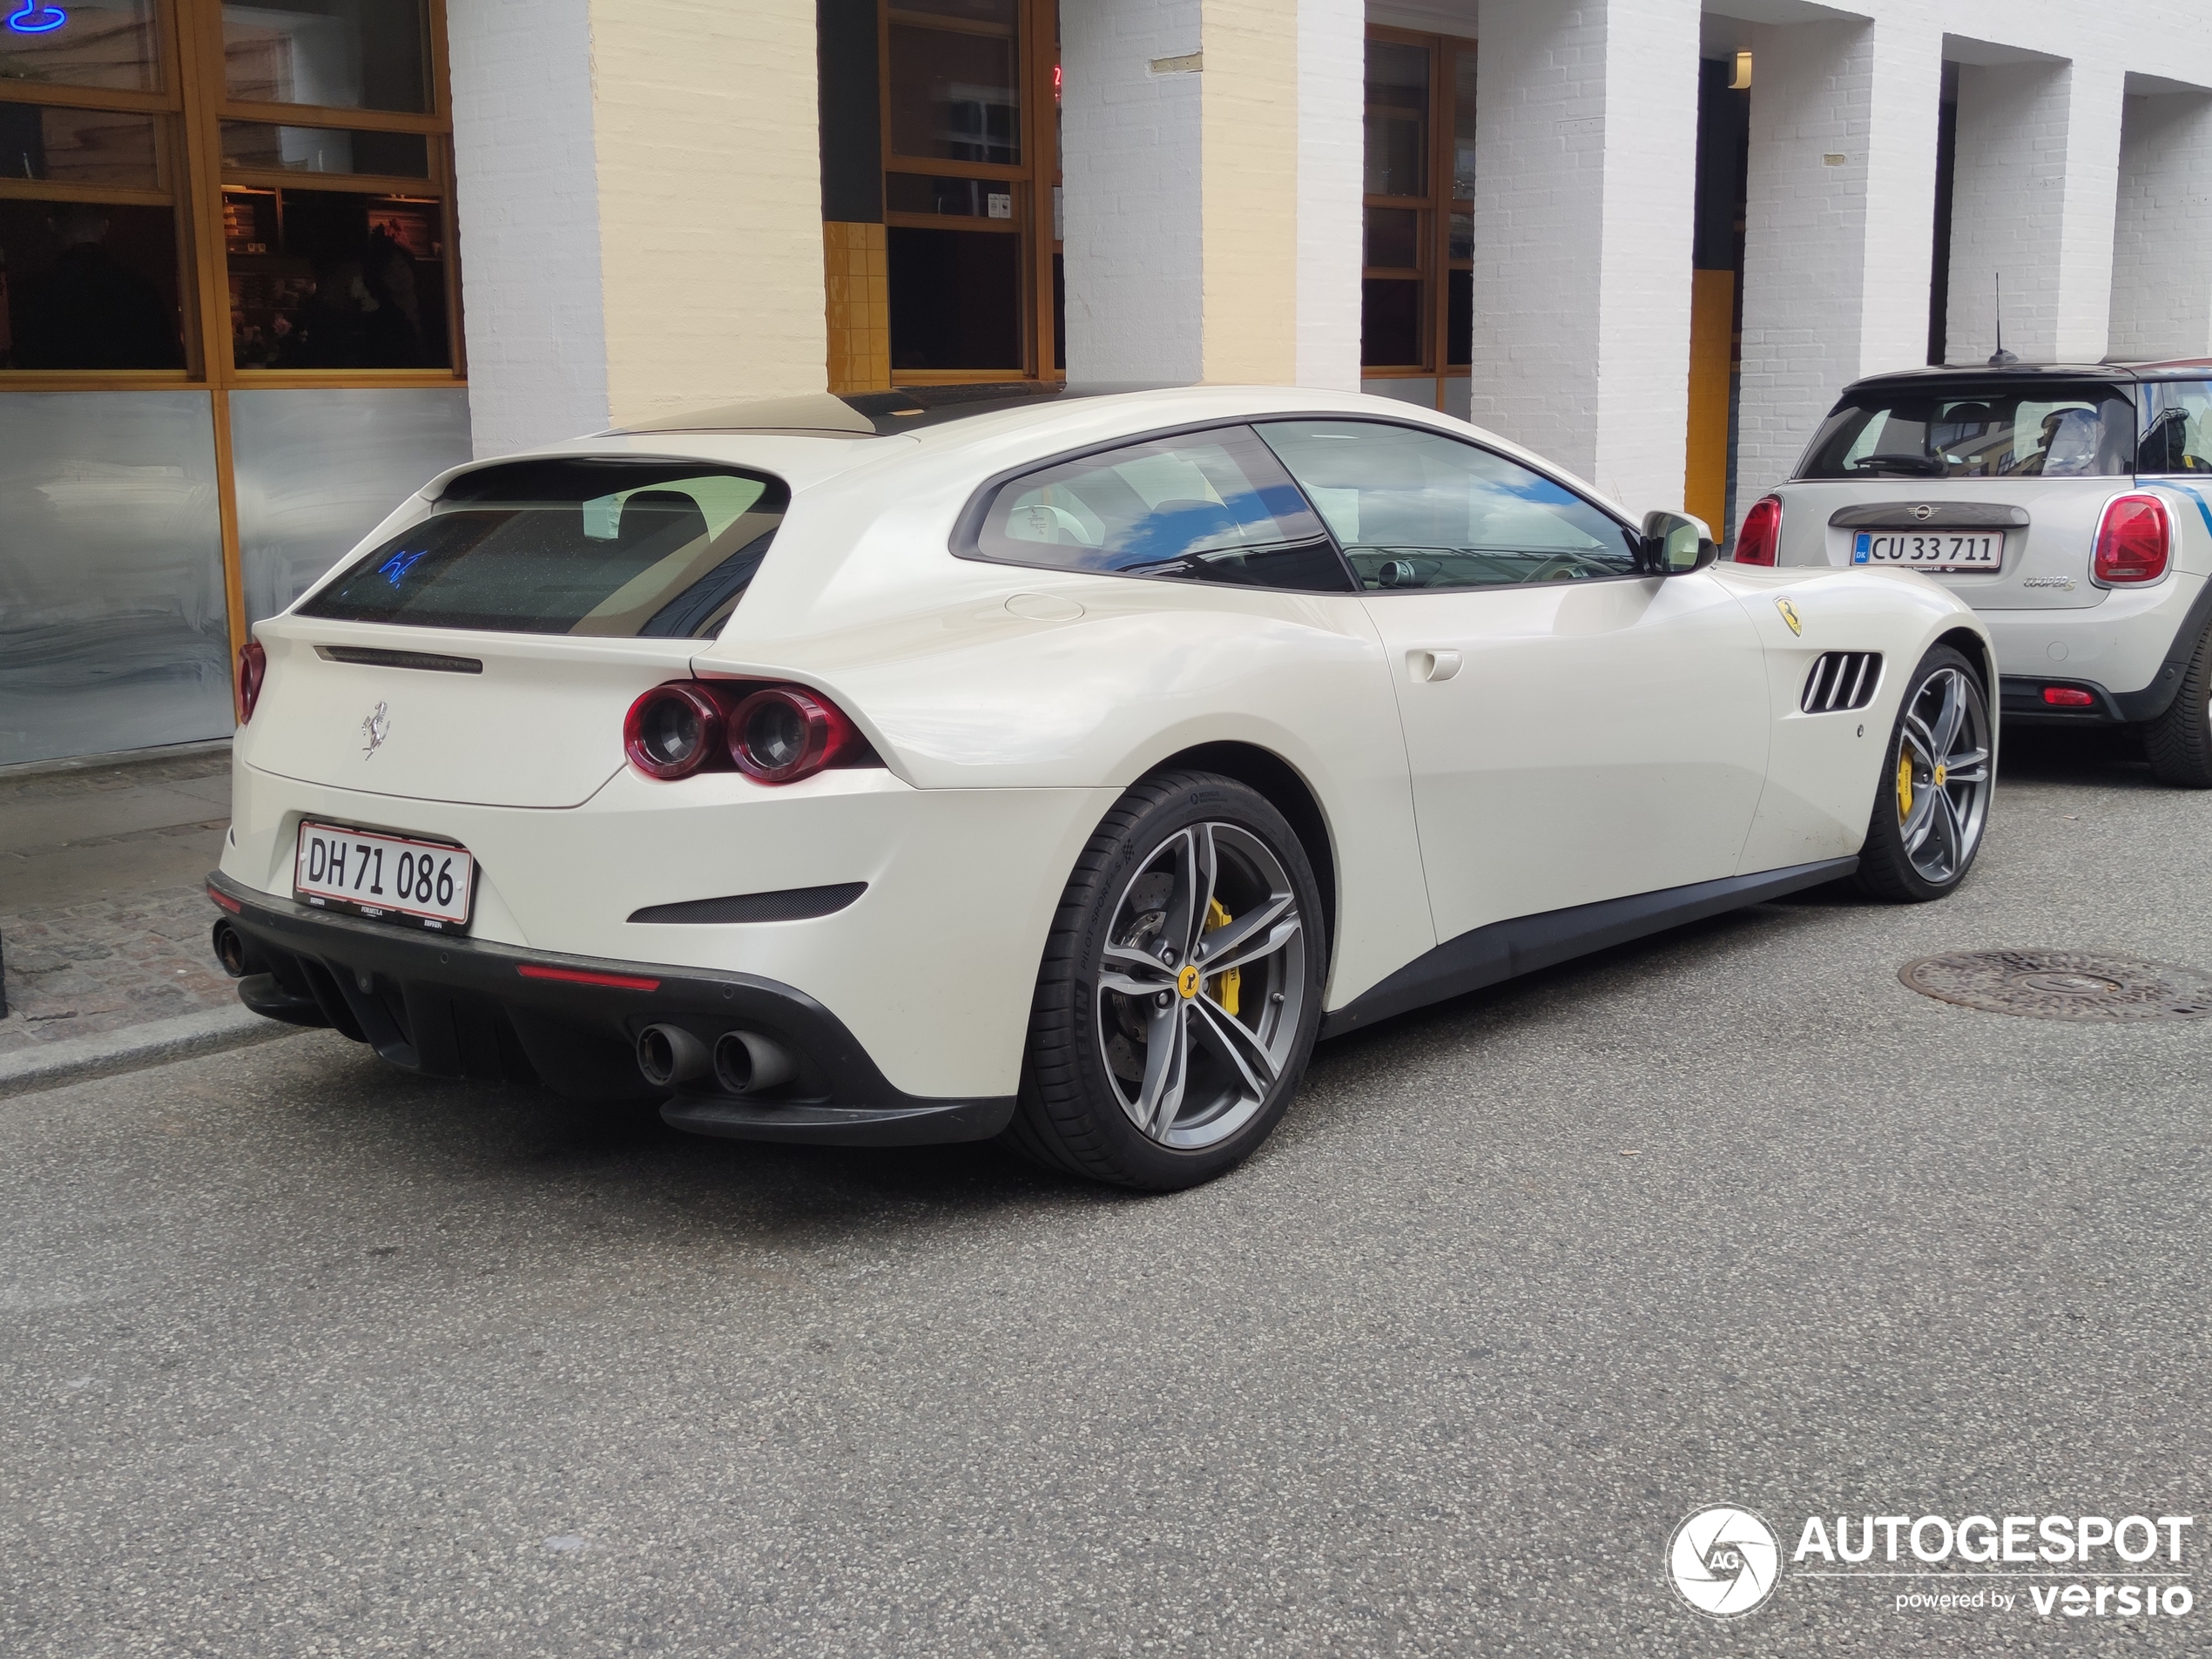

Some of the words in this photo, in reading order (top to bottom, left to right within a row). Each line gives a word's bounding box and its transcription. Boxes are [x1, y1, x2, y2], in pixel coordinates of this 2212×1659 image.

[1872, 537, 1905, 560] CU
[1911, 537, 1941, 560] 33
[1949, 537, 1991, 561] 711
[2023, 576, 2068, 588] COOPER
[308, 837, 347, 887] DH
[354, 844, 383, 895] 71
[397, 851, 454, 907] 086
[361, 906, 383, 916] FORMULA
[1080, 928, 1096, 970] PILOT
[1091, 880, 1115, 926] SPORT
